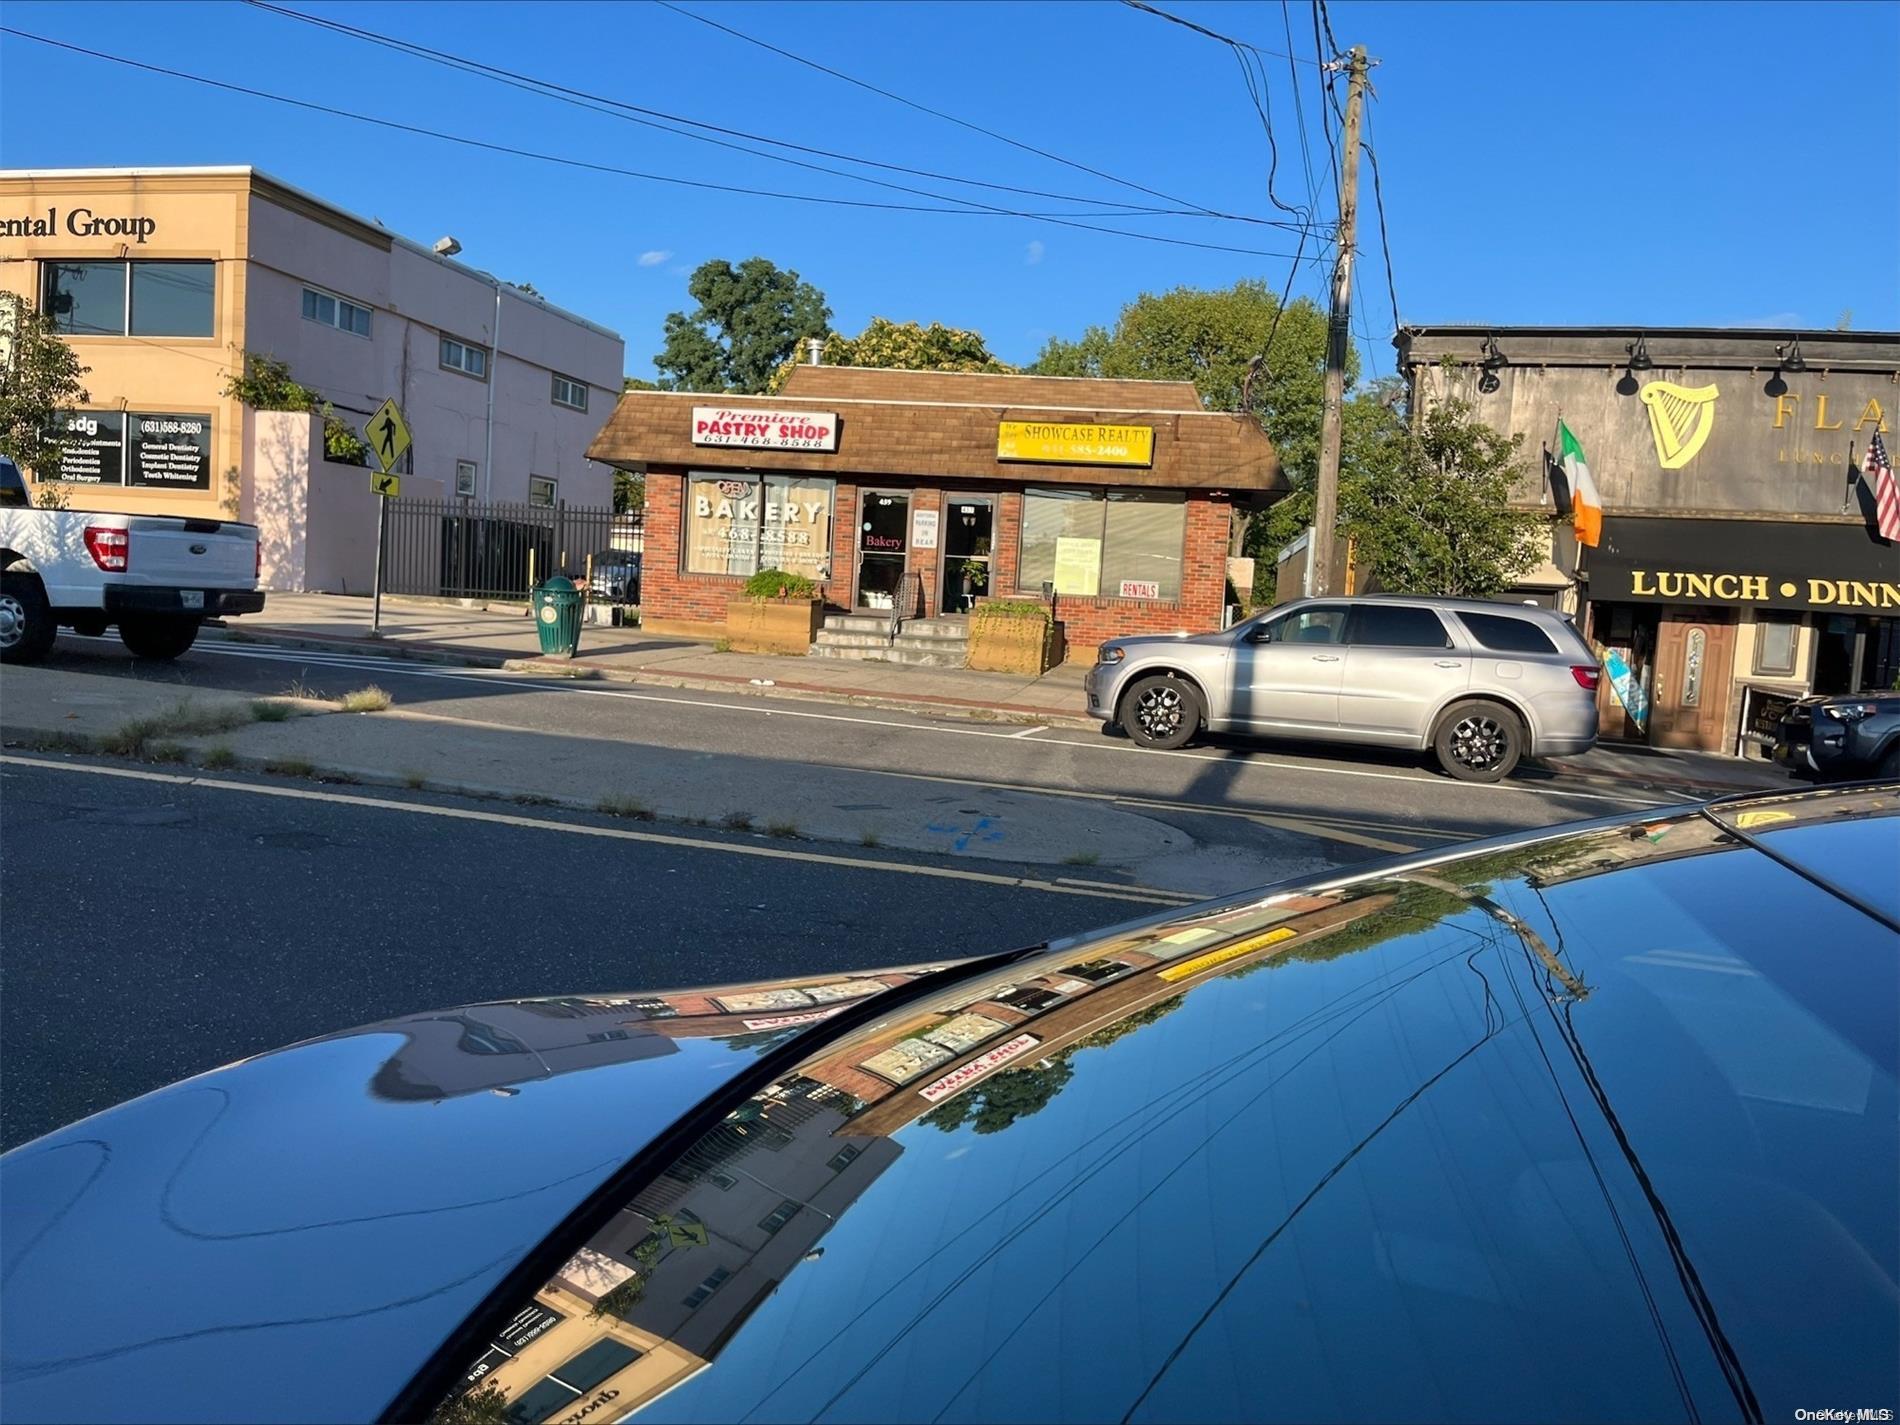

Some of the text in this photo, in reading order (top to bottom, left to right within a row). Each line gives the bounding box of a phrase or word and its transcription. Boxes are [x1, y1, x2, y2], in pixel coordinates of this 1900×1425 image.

[67, 208, 156, 243] Group
[716, 410, 811, 424] Premiere
[141, 420, 201, 434] (631)588-8280
[697, 421, 830, 440] PASTRY SHOP
[1025, 424, 1093, 441] SHOWCASE
[1099, 427, 1149, 443] REALTY
[142, 442, 199, 453] General Dentistry
[704, 435, 823, 448] 631-468-8588
[63, 456, 100, 465] Periodontics
[140, 452, 202, 463] Cosmetic Dentistry
[60, 465, 100, 474] Orthodontics
[141, 461, 199, 472] Implant Dentistry
[61, 473, 101, 483] Oral Surgery
[143, 471, 198, 482] Teeth Whitening
[696, 496, 824, 523] BAKERY
[866, 535, 902, 550] Bakery
[1123, 583, 1156, 598] RENTALS
[1631, 571, 1900, 609] LUNCH DINN
